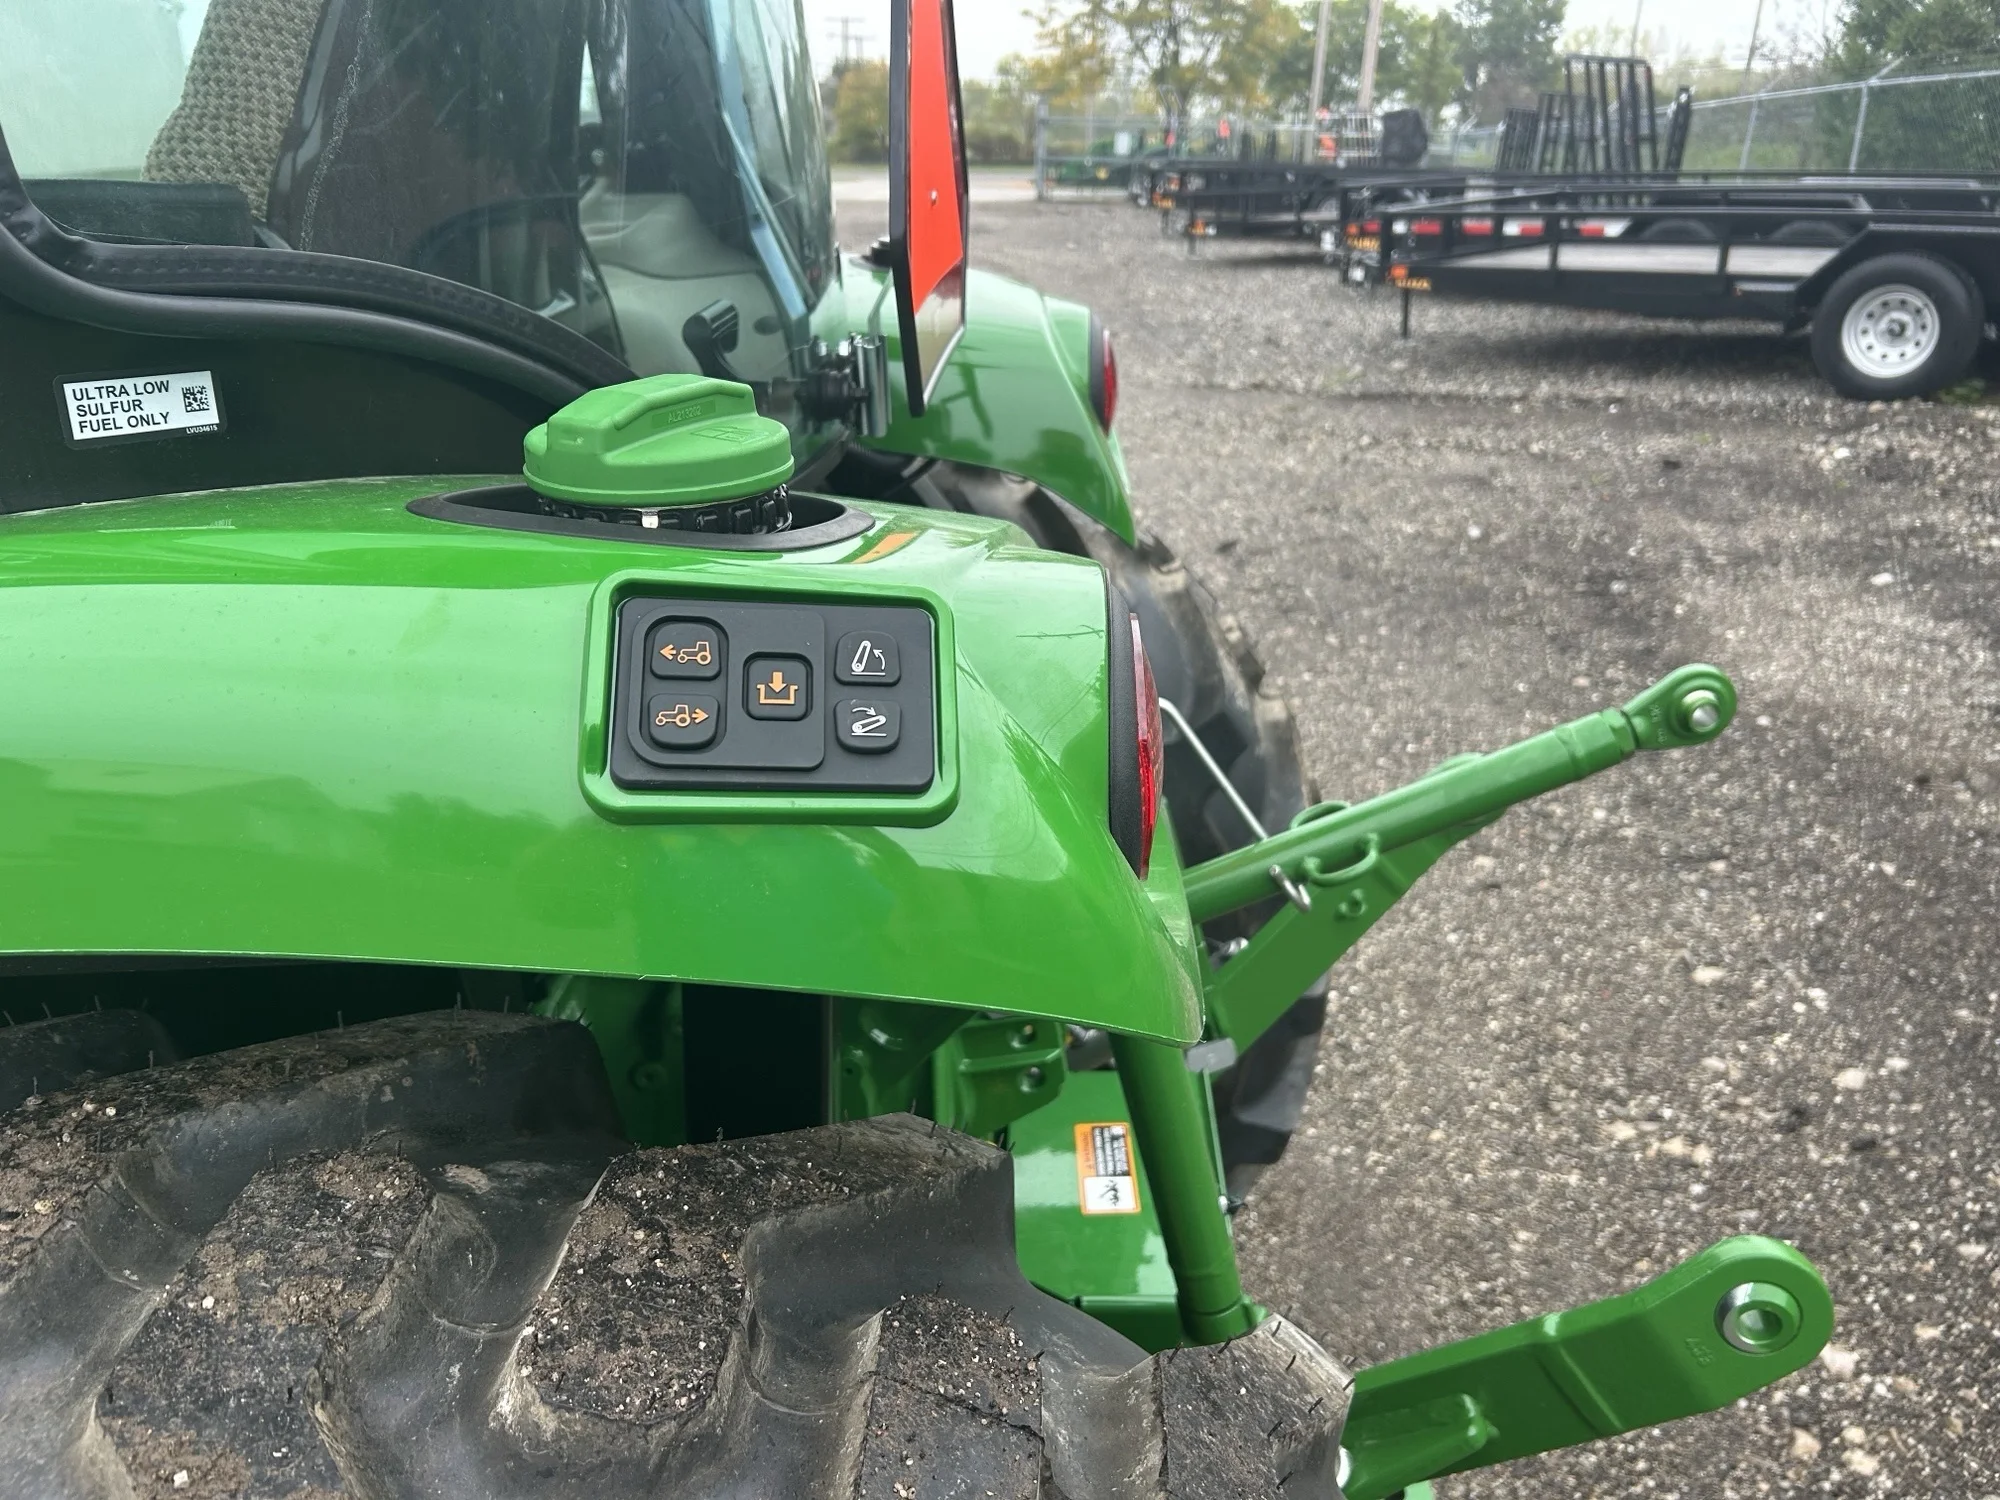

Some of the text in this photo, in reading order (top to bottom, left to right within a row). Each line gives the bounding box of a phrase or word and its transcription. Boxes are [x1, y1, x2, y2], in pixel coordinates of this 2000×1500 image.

[72, 380, 170, 401] ULTRA LOW
[76, 399, 144, 417] SULFUR
[79, 412, 170, 433] FUEL ONLY
